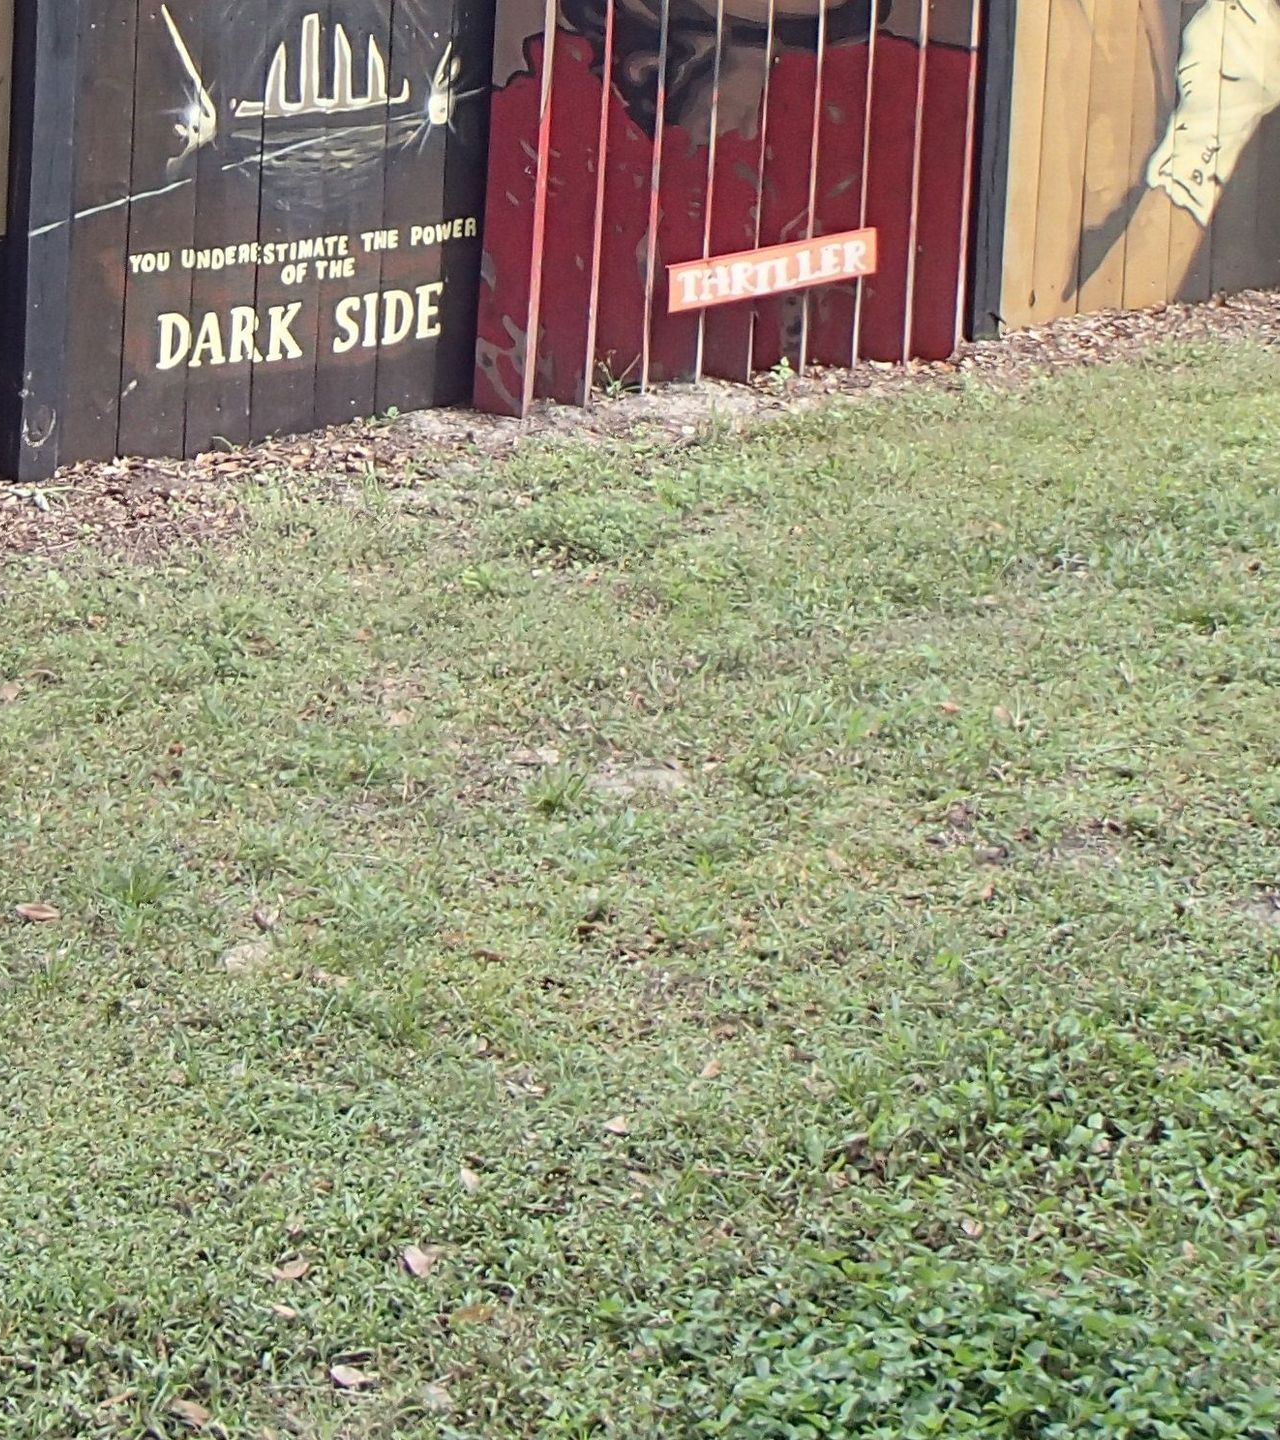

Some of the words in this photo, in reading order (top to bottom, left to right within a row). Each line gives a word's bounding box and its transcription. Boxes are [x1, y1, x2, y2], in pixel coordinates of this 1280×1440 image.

[129, 251, 170, 274] YOU
[181, 235, 350, 271] UNDERESTIMATE
[361, 228, 400, 253] THE
[410, 217, 478, 246] POWER
[281, 261, 308, 285] OF
[315, 257, 356, 279] THE
[676, 239, 868, 305] THRILLER
[155, 302, 304, 371] DARK
[332, 280, 445, 354] SIDE
